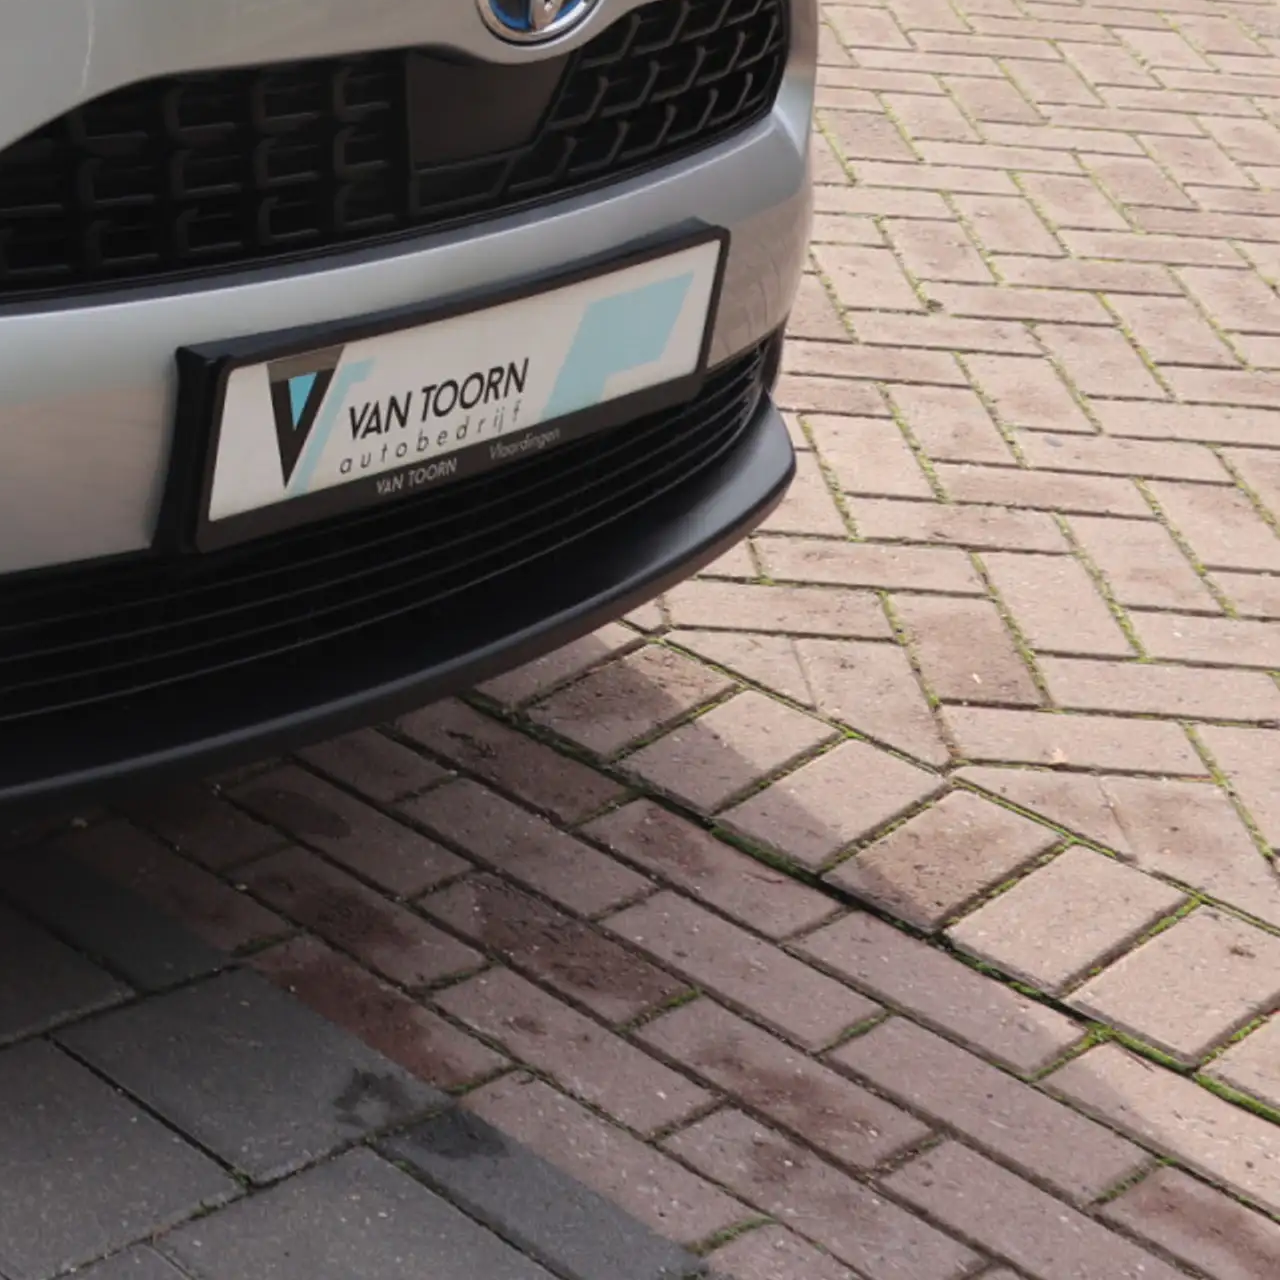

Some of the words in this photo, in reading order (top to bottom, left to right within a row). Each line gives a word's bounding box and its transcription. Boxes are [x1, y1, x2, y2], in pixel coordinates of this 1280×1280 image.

[348, 391, 412, 440] VAN
[421, 357, 530, 423] TOORN
[339, 399, 523, 476] autobedrijf
[376, 474, 404, 496] VAN
[409, 458, 458, 487] TOORN
